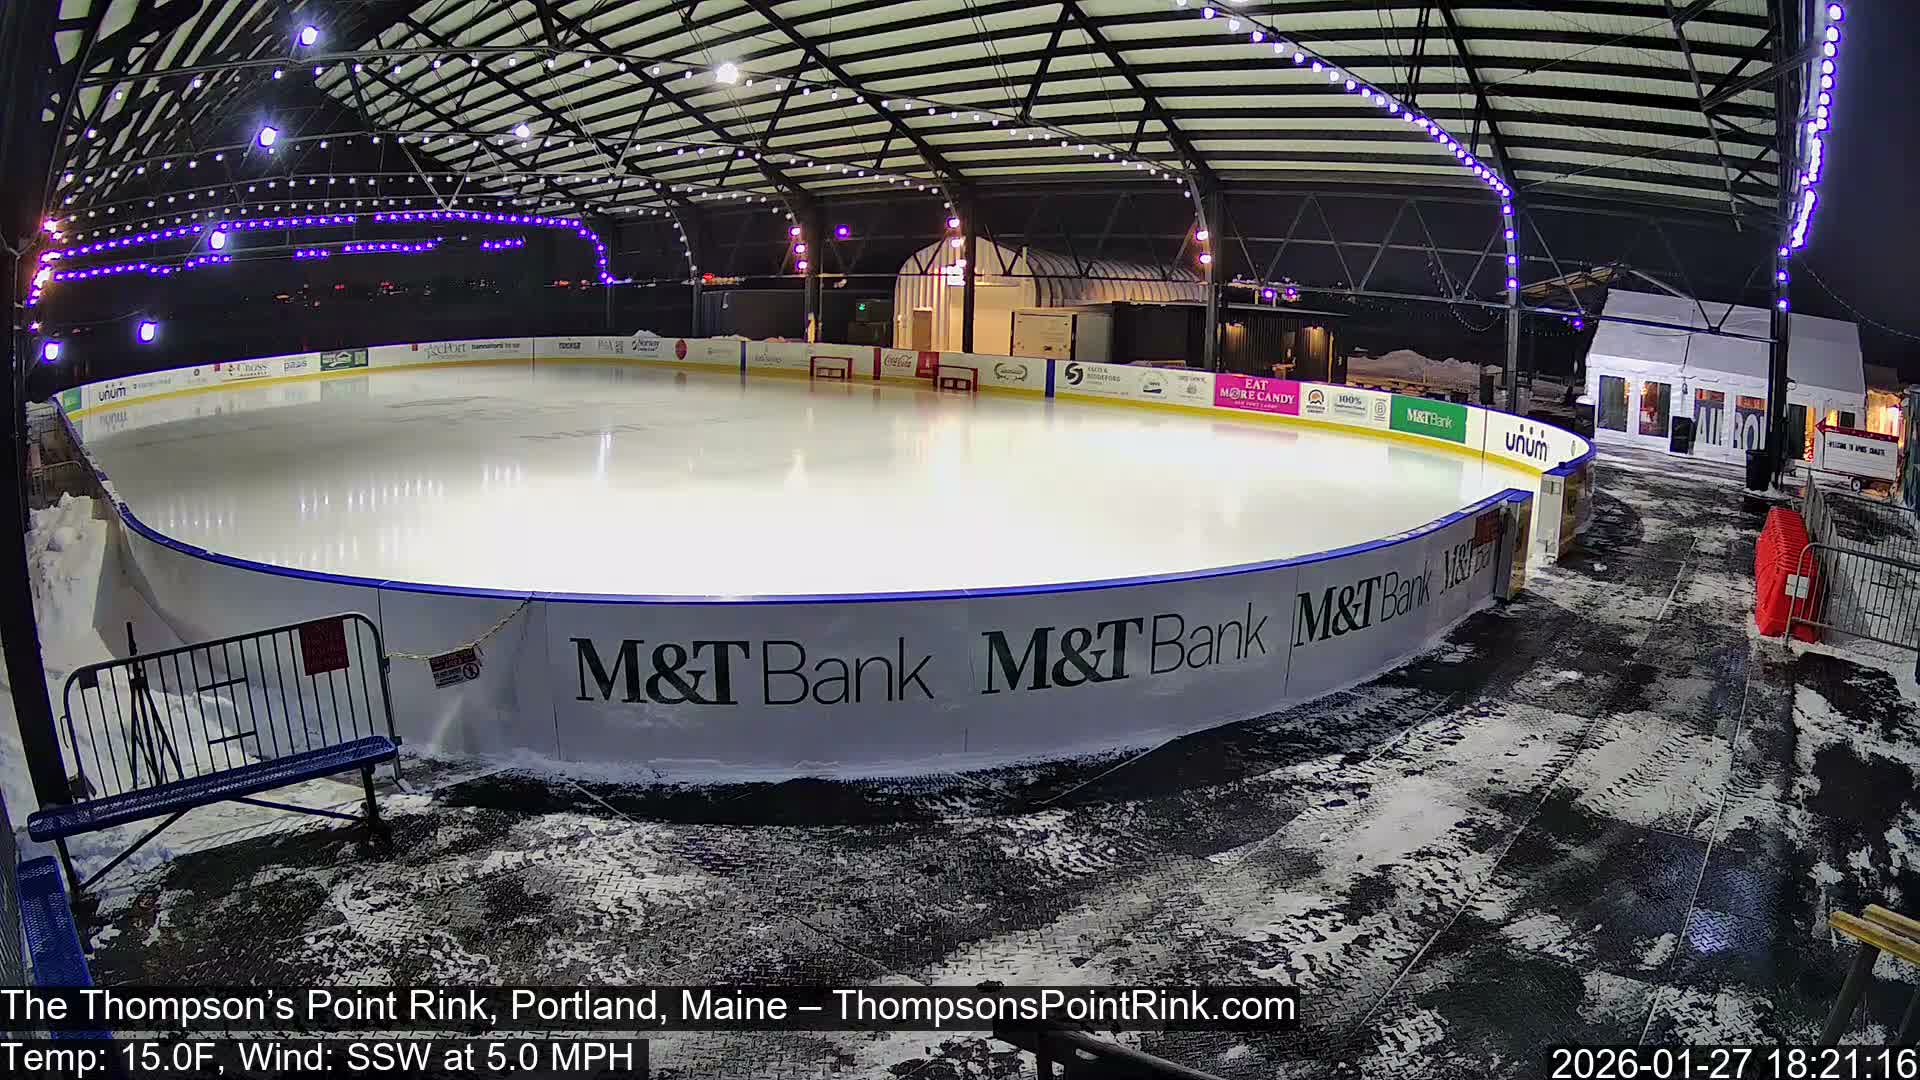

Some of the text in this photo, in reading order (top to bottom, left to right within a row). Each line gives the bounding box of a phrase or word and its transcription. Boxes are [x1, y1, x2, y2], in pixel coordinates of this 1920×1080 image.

[1220, 387, 1295, 405] MORE CANDY
[1245, 378, 1269, 391] EAT
[1407, 408, 1453, 429] M&T Bank
[1506, 430, 1548, 462] unum
[1440, 537, 1474, 595] M&T
[1294, 560, 1432, 647] M&T Bank
[569, 637, 935, 705] M&T Bank
[981, 602, 1269, 695] M&T Bank
